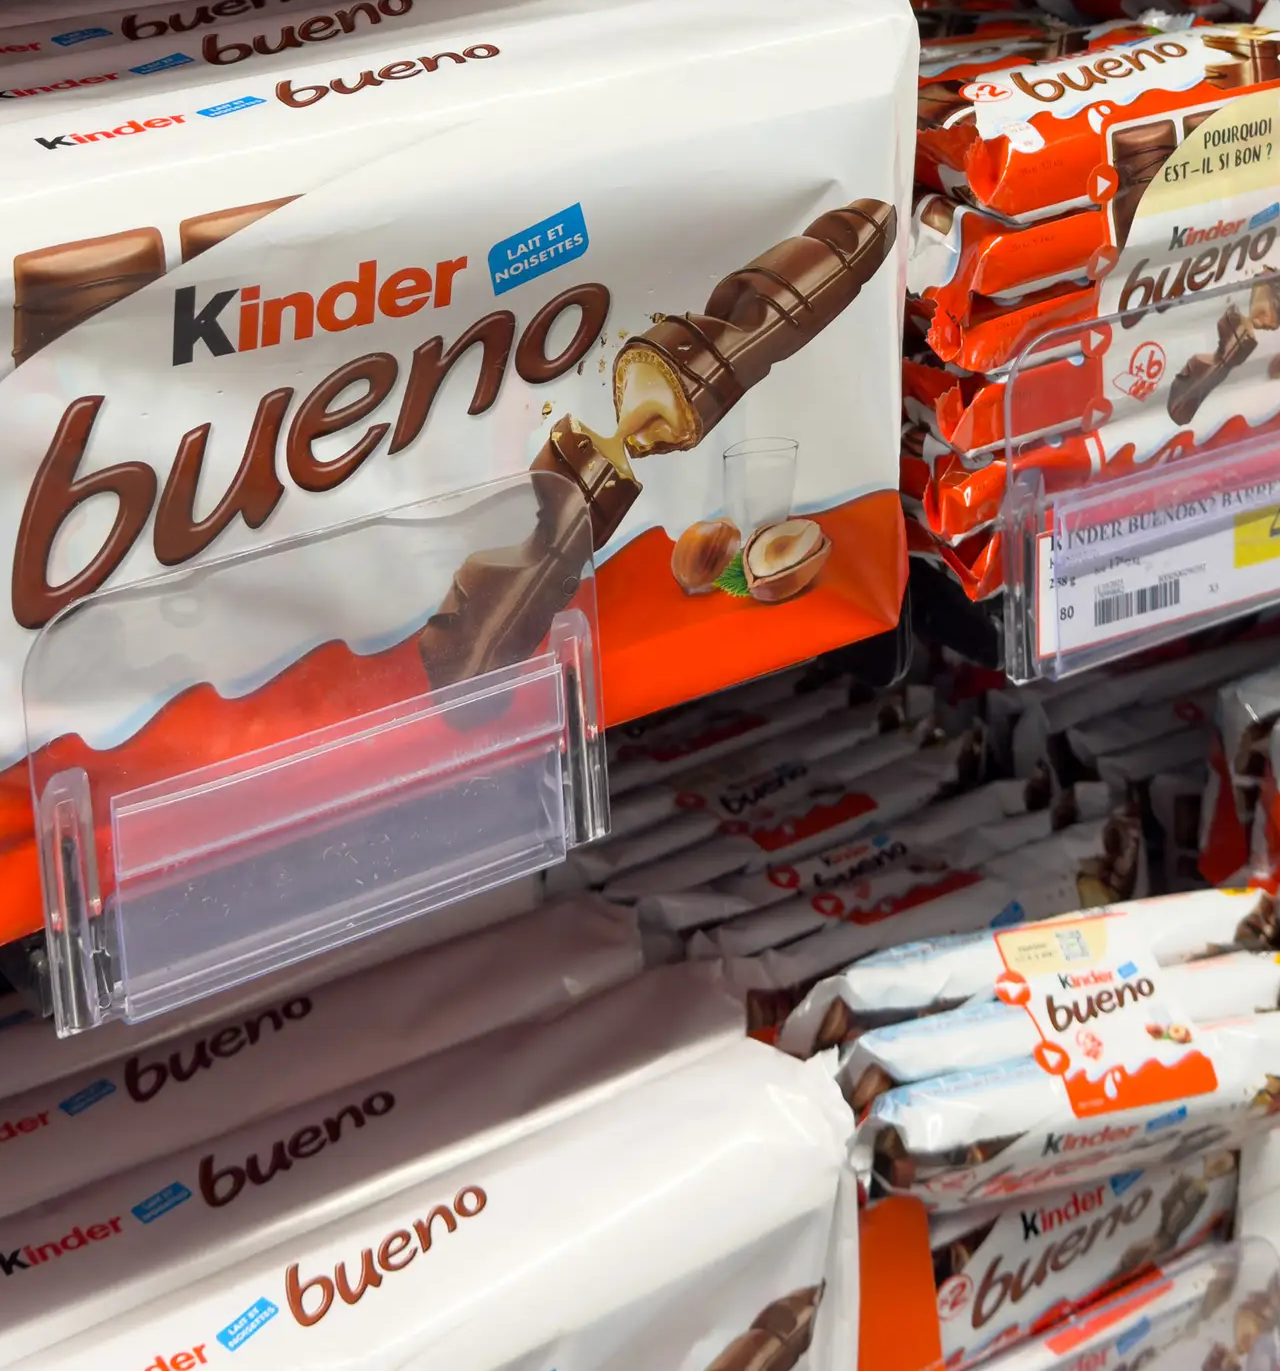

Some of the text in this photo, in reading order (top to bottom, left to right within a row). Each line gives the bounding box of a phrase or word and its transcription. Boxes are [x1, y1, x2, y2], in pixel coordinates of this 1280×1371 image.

[272, 42, 500, 109] bueno
[1009, 39, 1189, 103] bueno
[34, 109, 187, 150] Kinder
[1203, 118, 1273, 150] POURQUOI
[1218, 151, 1231, 173] SI
[1233, 146, 1262, 169] BON
[494, 232, 584, 284] NOISETTES
[506, 223, 564, 260] LAIT ET
[1169, 216, 1246, 252] Kinder
[1117, 225, 1277, 330] bueno
[171, 250, 471, 367] Kinder
[9, 280, 611, 632] bueno
[1059, 605, 1075, 621] 80
[1045, 974, 1156, 1032] bueno
[1057, 969, 1114, 991] Kinder
[123, 995, 313, 1103] bueno
[198, 1089, 396, 1208] bueno
[1020, 1182, 1106, 1241] Kinder
[284, 1183, 488, 1328] bueno
[971, 1187, 1154, 1331] bueno
